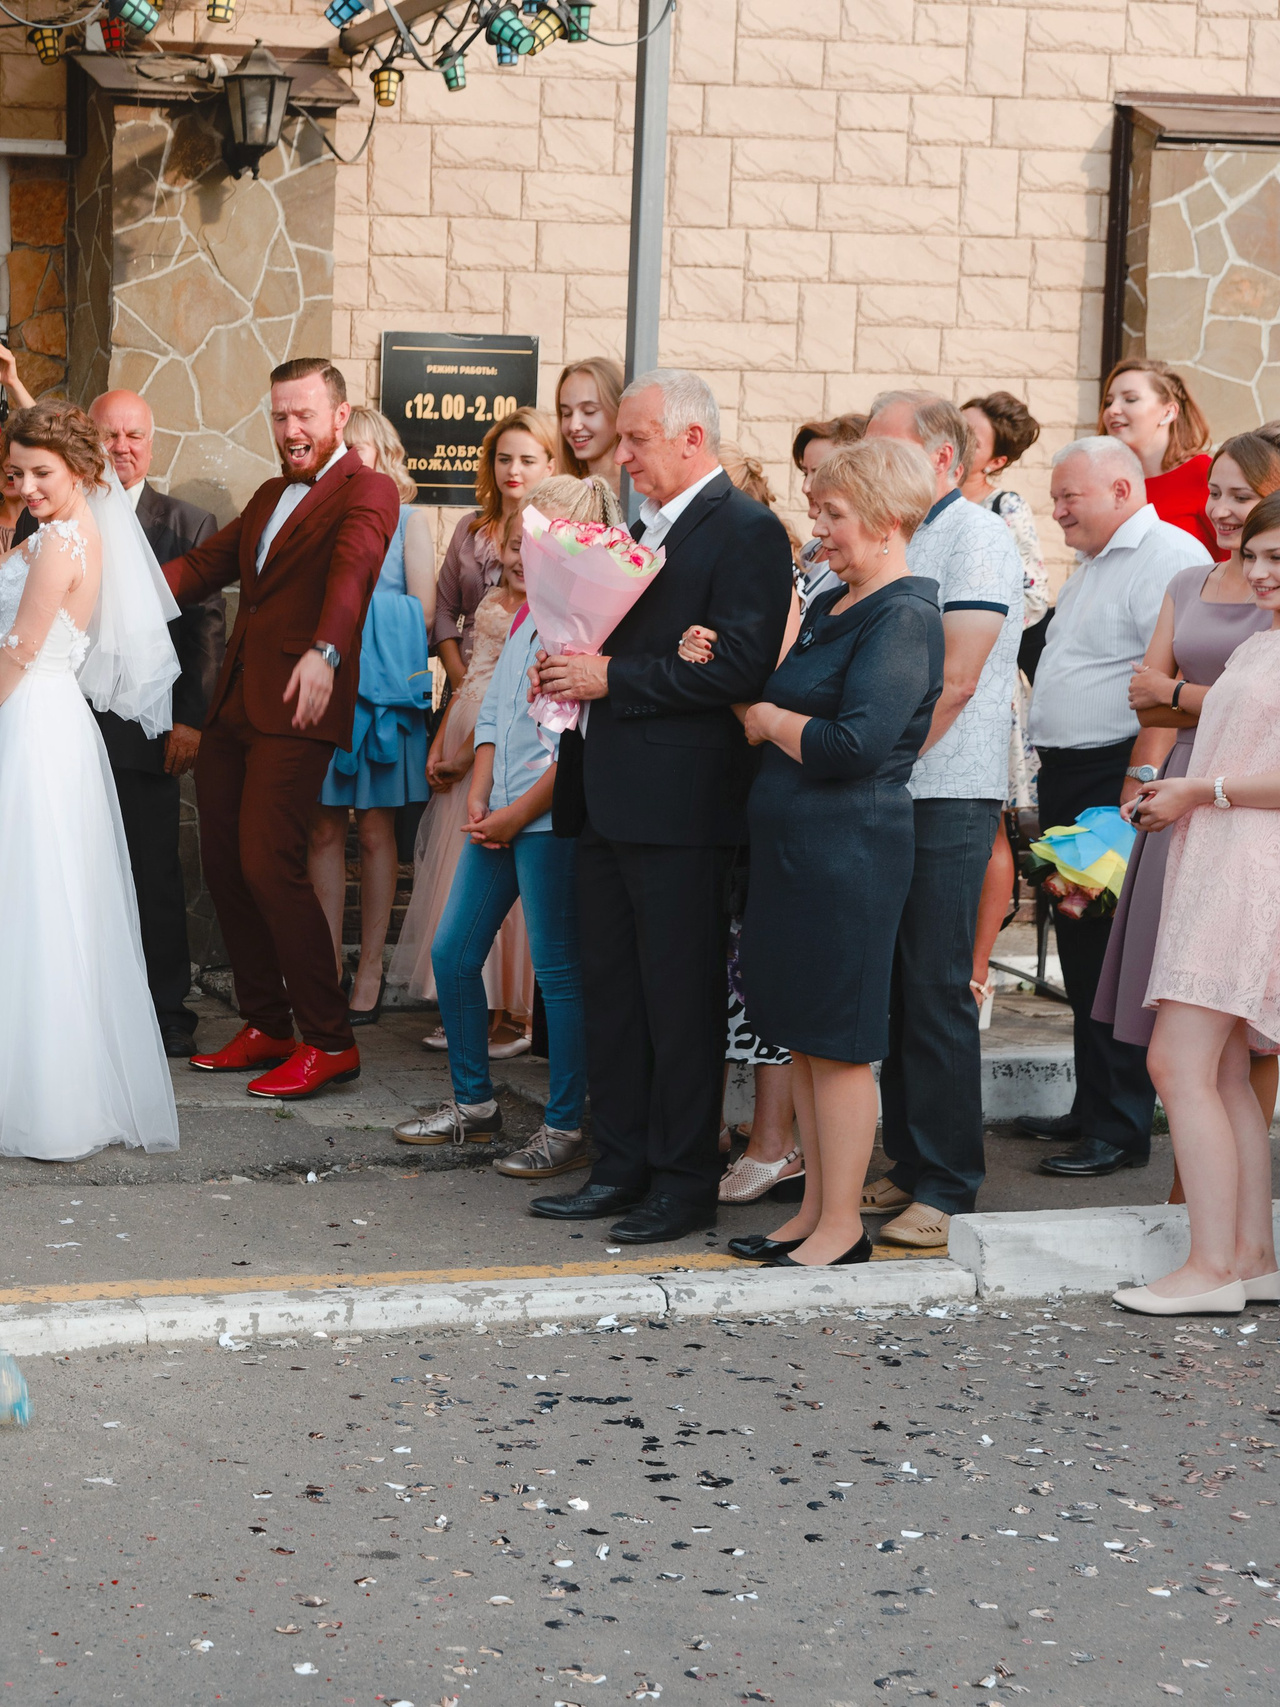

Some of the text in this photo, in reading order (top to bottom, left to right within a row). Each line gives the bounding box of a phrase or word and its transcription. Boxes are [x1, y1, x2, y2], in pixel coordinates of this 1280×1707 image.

[426, 364, 498, 376] РЕЖИМ РАБОТЫ:
[434, 444, 485, 458] ДОБРО
